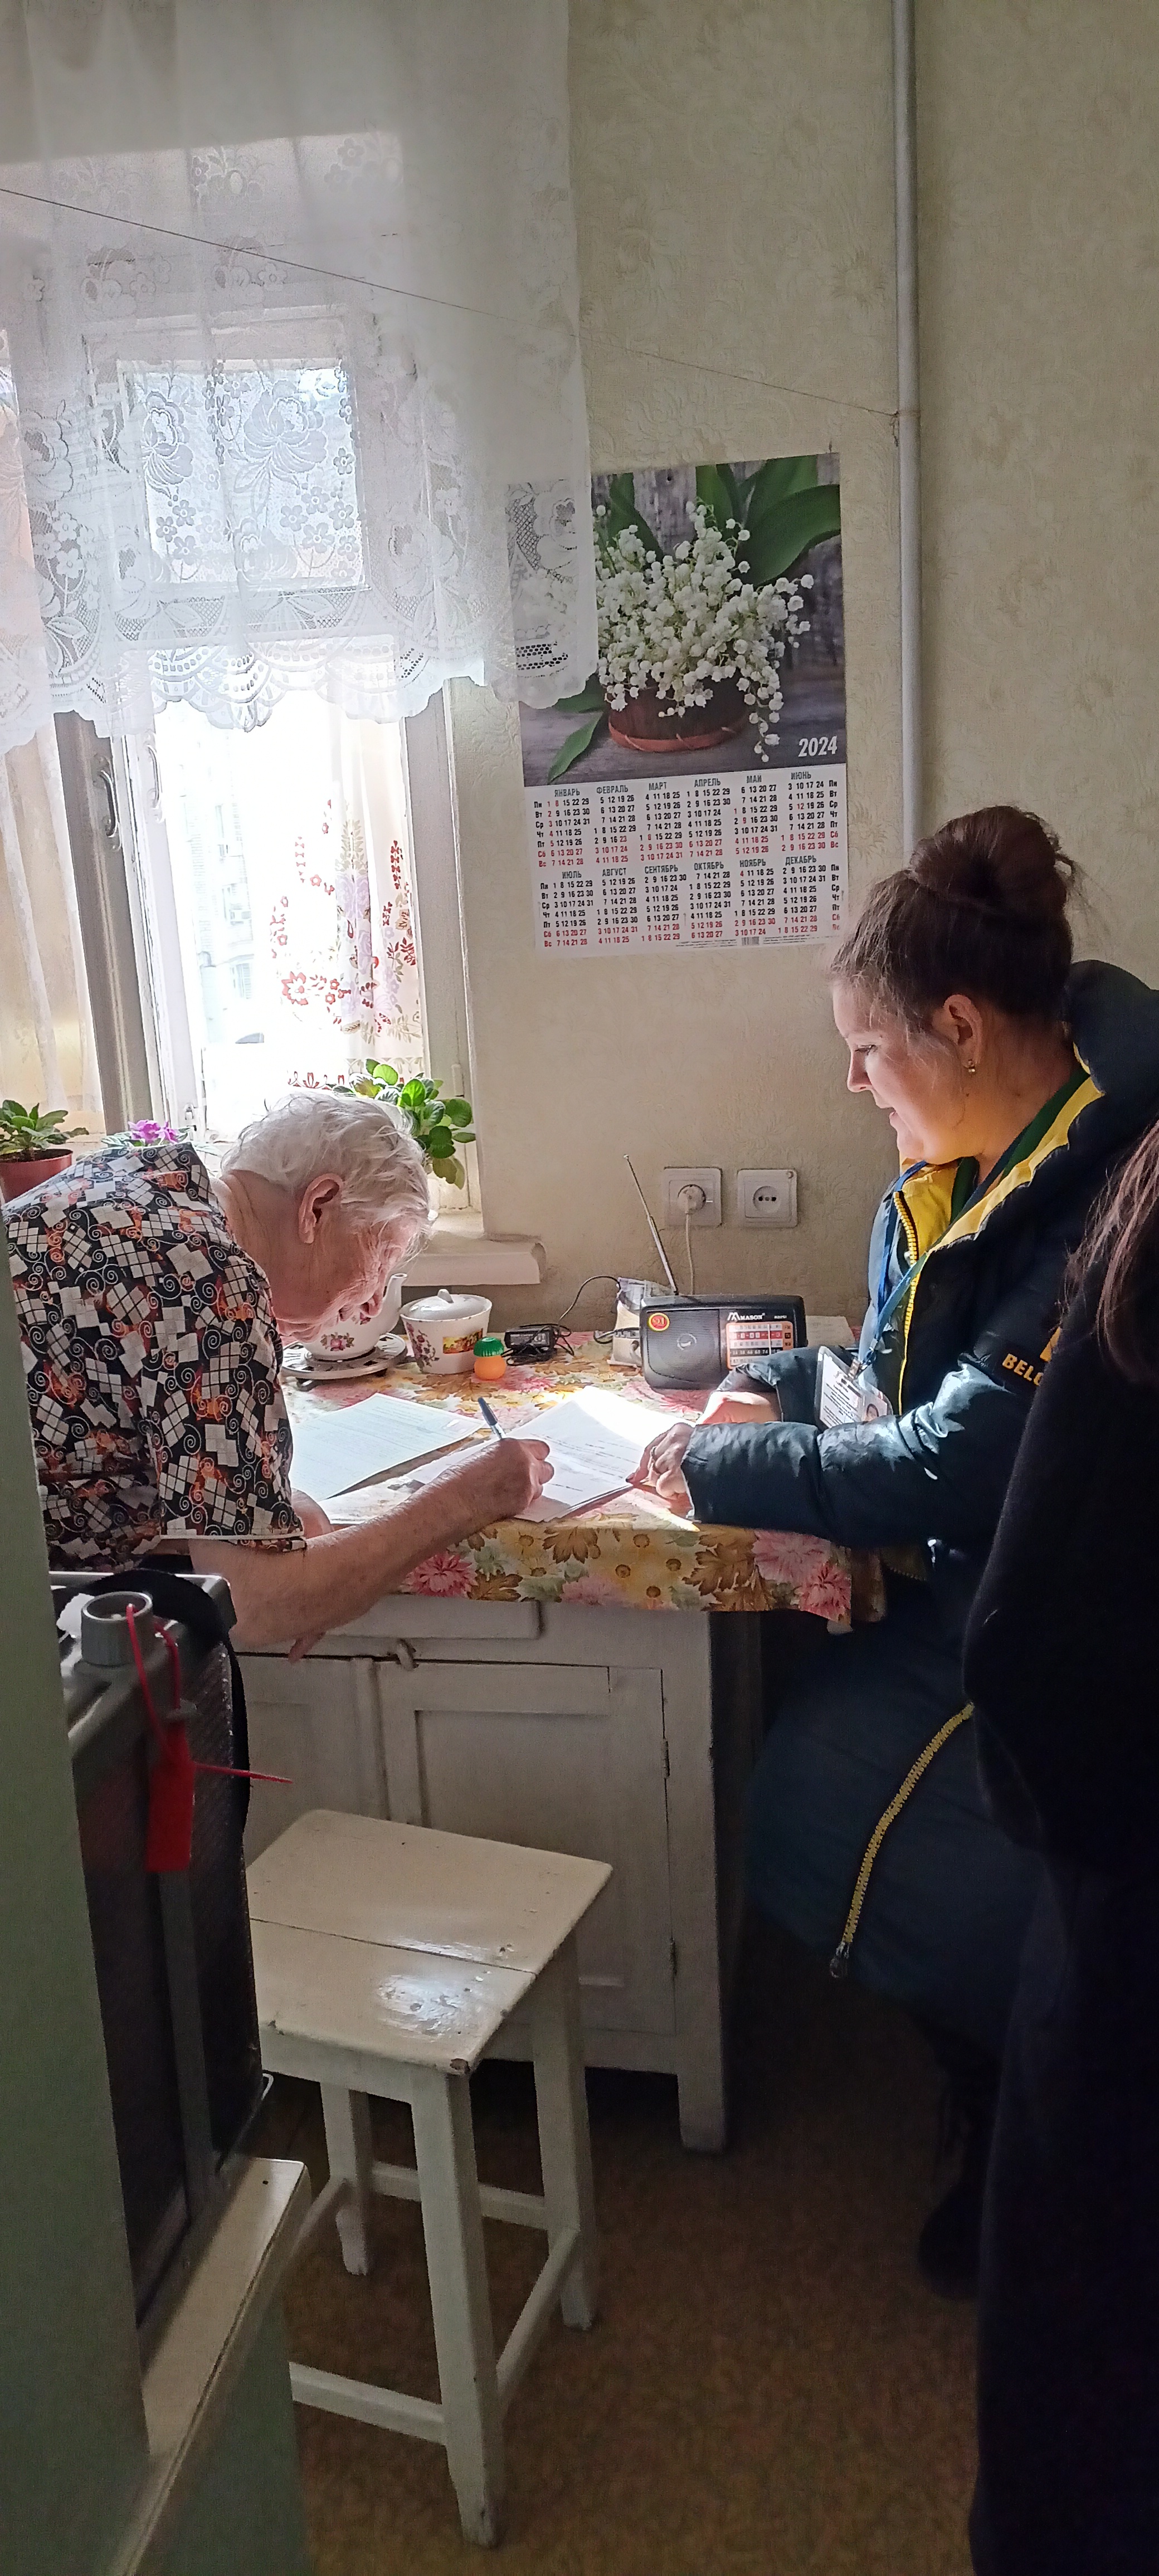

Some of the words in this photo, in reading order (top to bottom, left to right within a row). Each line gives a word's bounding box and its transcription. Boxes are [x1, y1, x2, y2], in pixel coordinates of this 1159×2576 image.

[798, 735, 837, 757] 2024
[791, 771, 811, 780] ИЮНЬ
[649, 782, 667, 791] МАРТ
[694, 778, 721, 787] АПРЕЛЬ
[554, 788, 580, 797] ЯНВАРЬ
[596, 784, 629, 794] ФЕВРАЛЬ
[829, 800, 837, 809] Ср
[535, 821, 544, 829] Ср
[739, 858, 766, 867] НОЯБРЬ
[785, 855, 817, 866] ДЕКАБРЬ
[644, 864, 678, 874] СЕНТЯБРЬ
[694, 861, 724, 871] ОКТЯБРЬ
[562, 871, 582, 879] ИЮЛЬ
[602, 867, 626, 876] АВГУСТ
[831, 884, 840, 892] Ср
